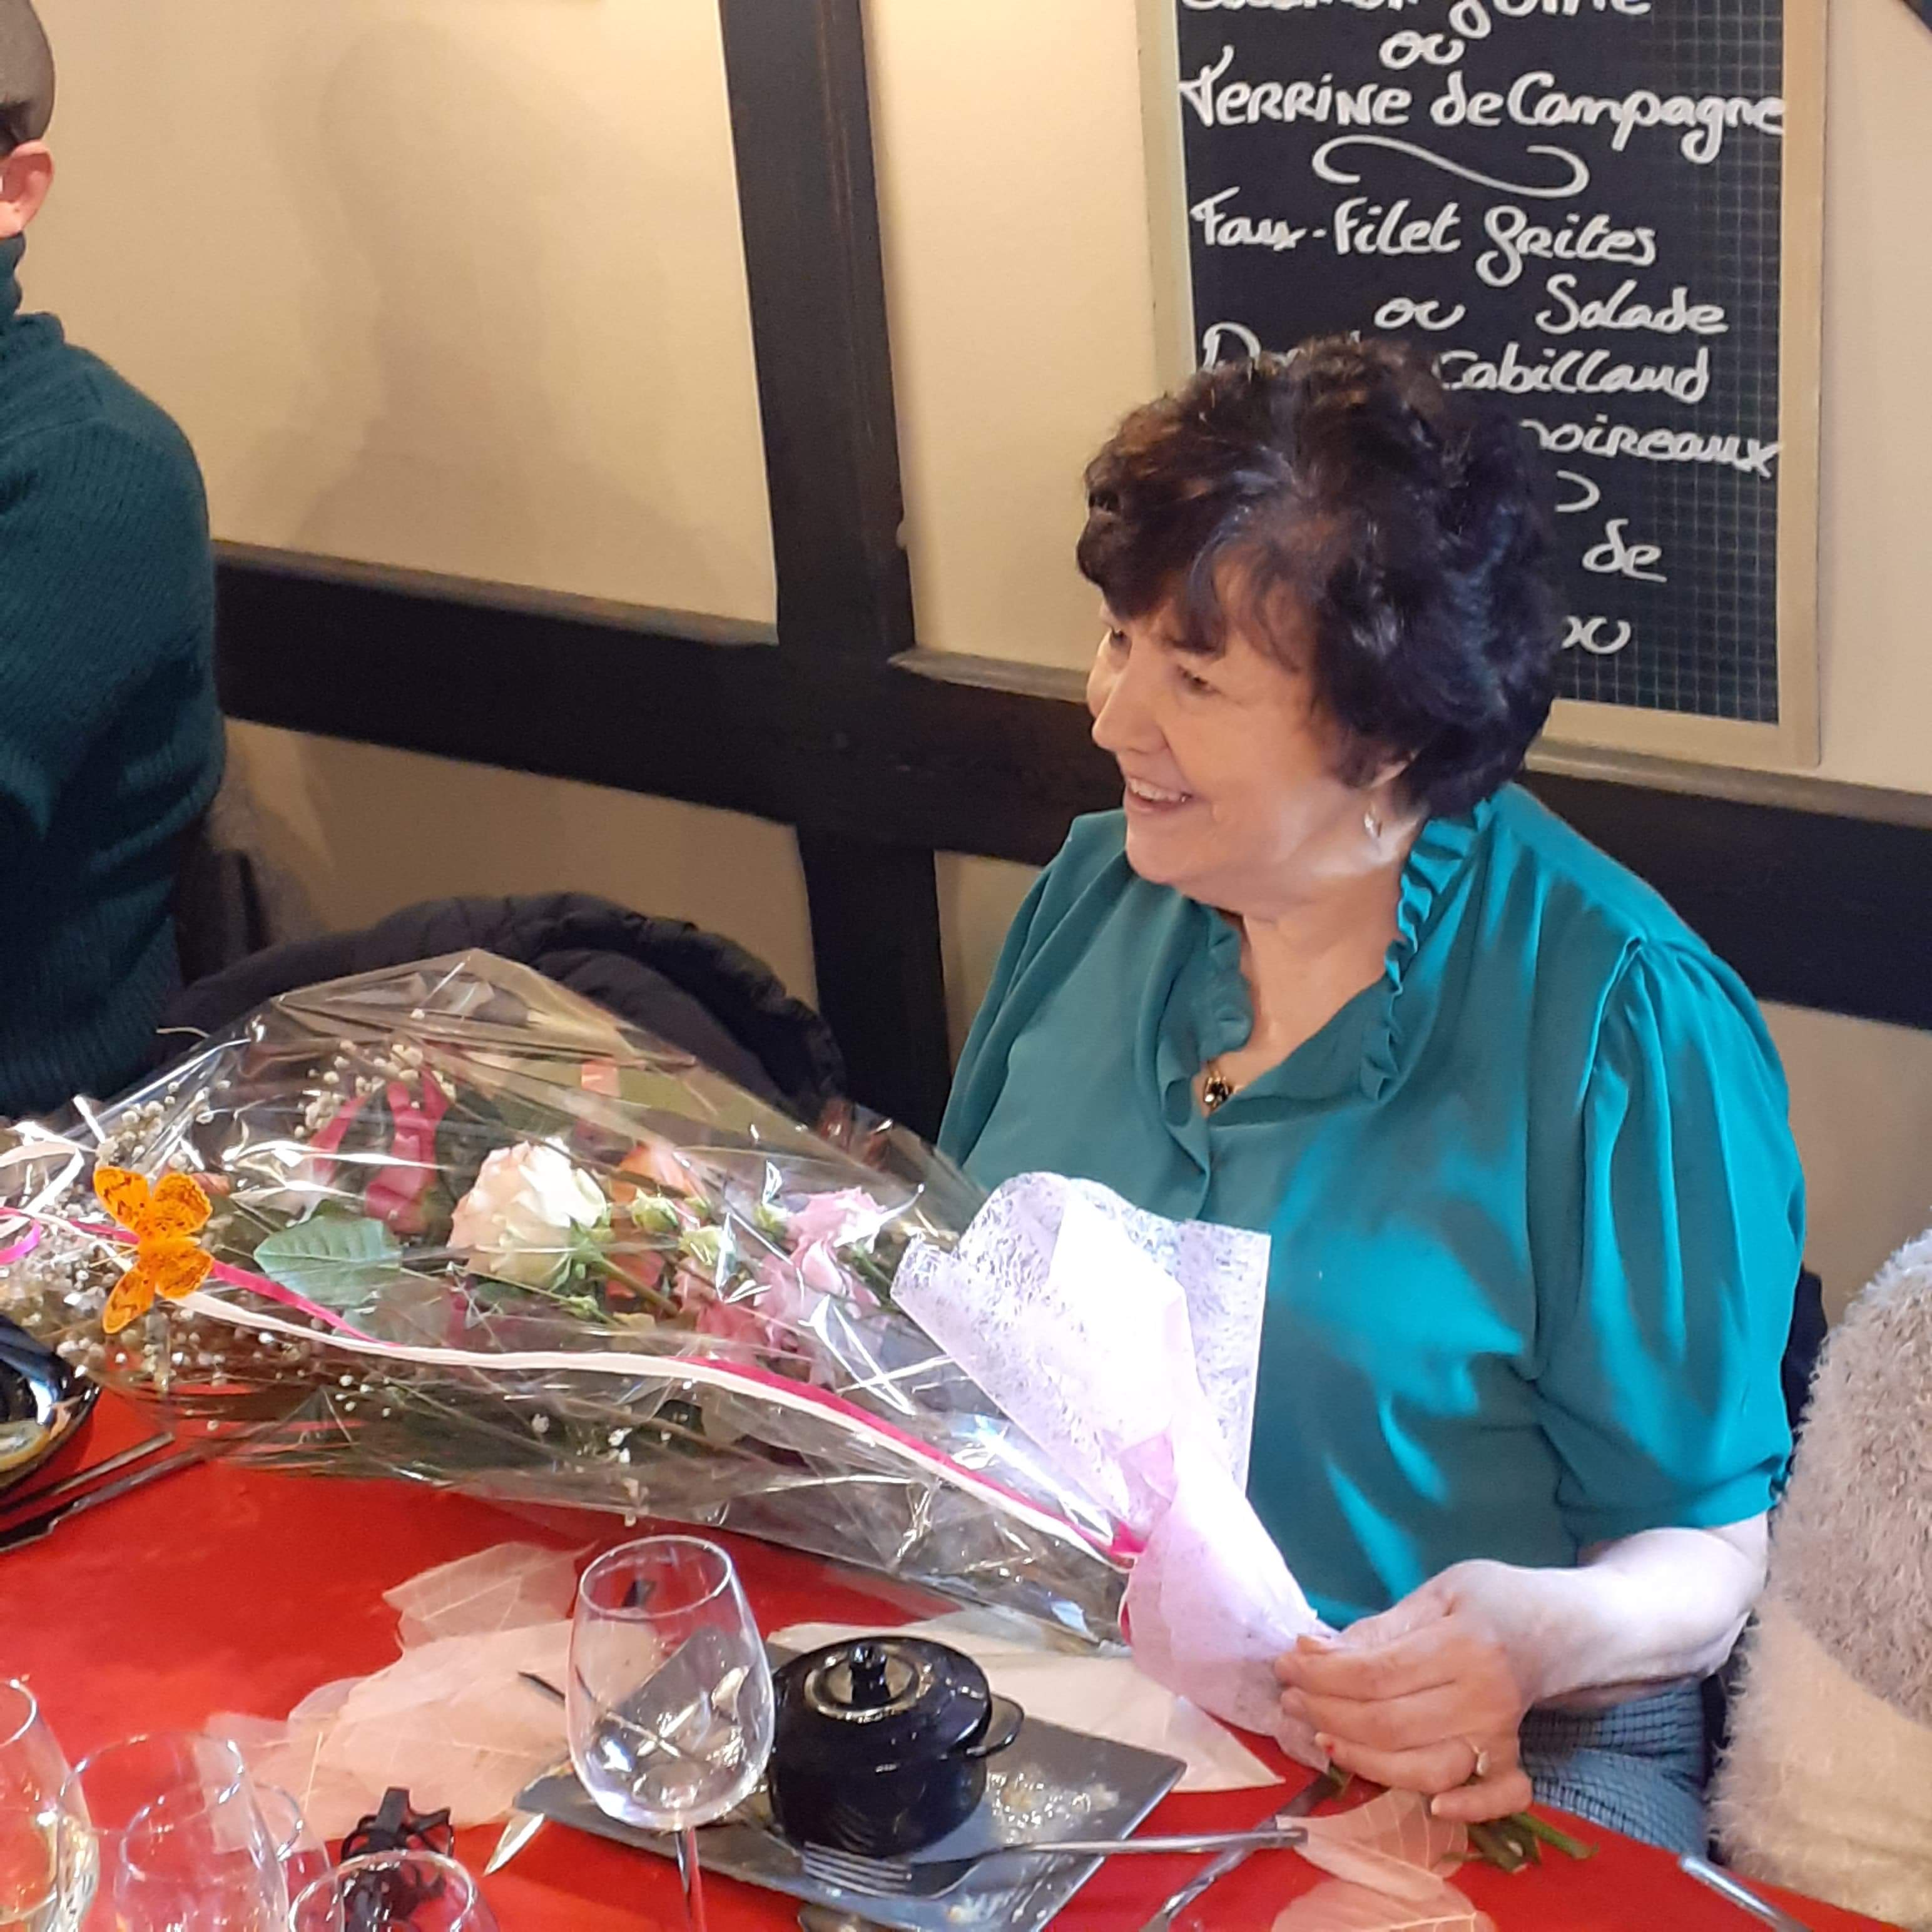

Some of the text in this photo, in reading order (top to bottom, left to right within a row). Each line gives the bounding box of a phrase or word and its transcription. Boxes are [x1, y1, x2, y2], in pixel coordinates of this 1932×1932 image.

[1430, 70, 1504, 126] de
[1507, 71, 1784, 164] Campagne
[1535, 273, 1729, 335] Salade
[1432, 342, 1709, 404] Cabillaud
[1582, 519, 1667, 583] de
